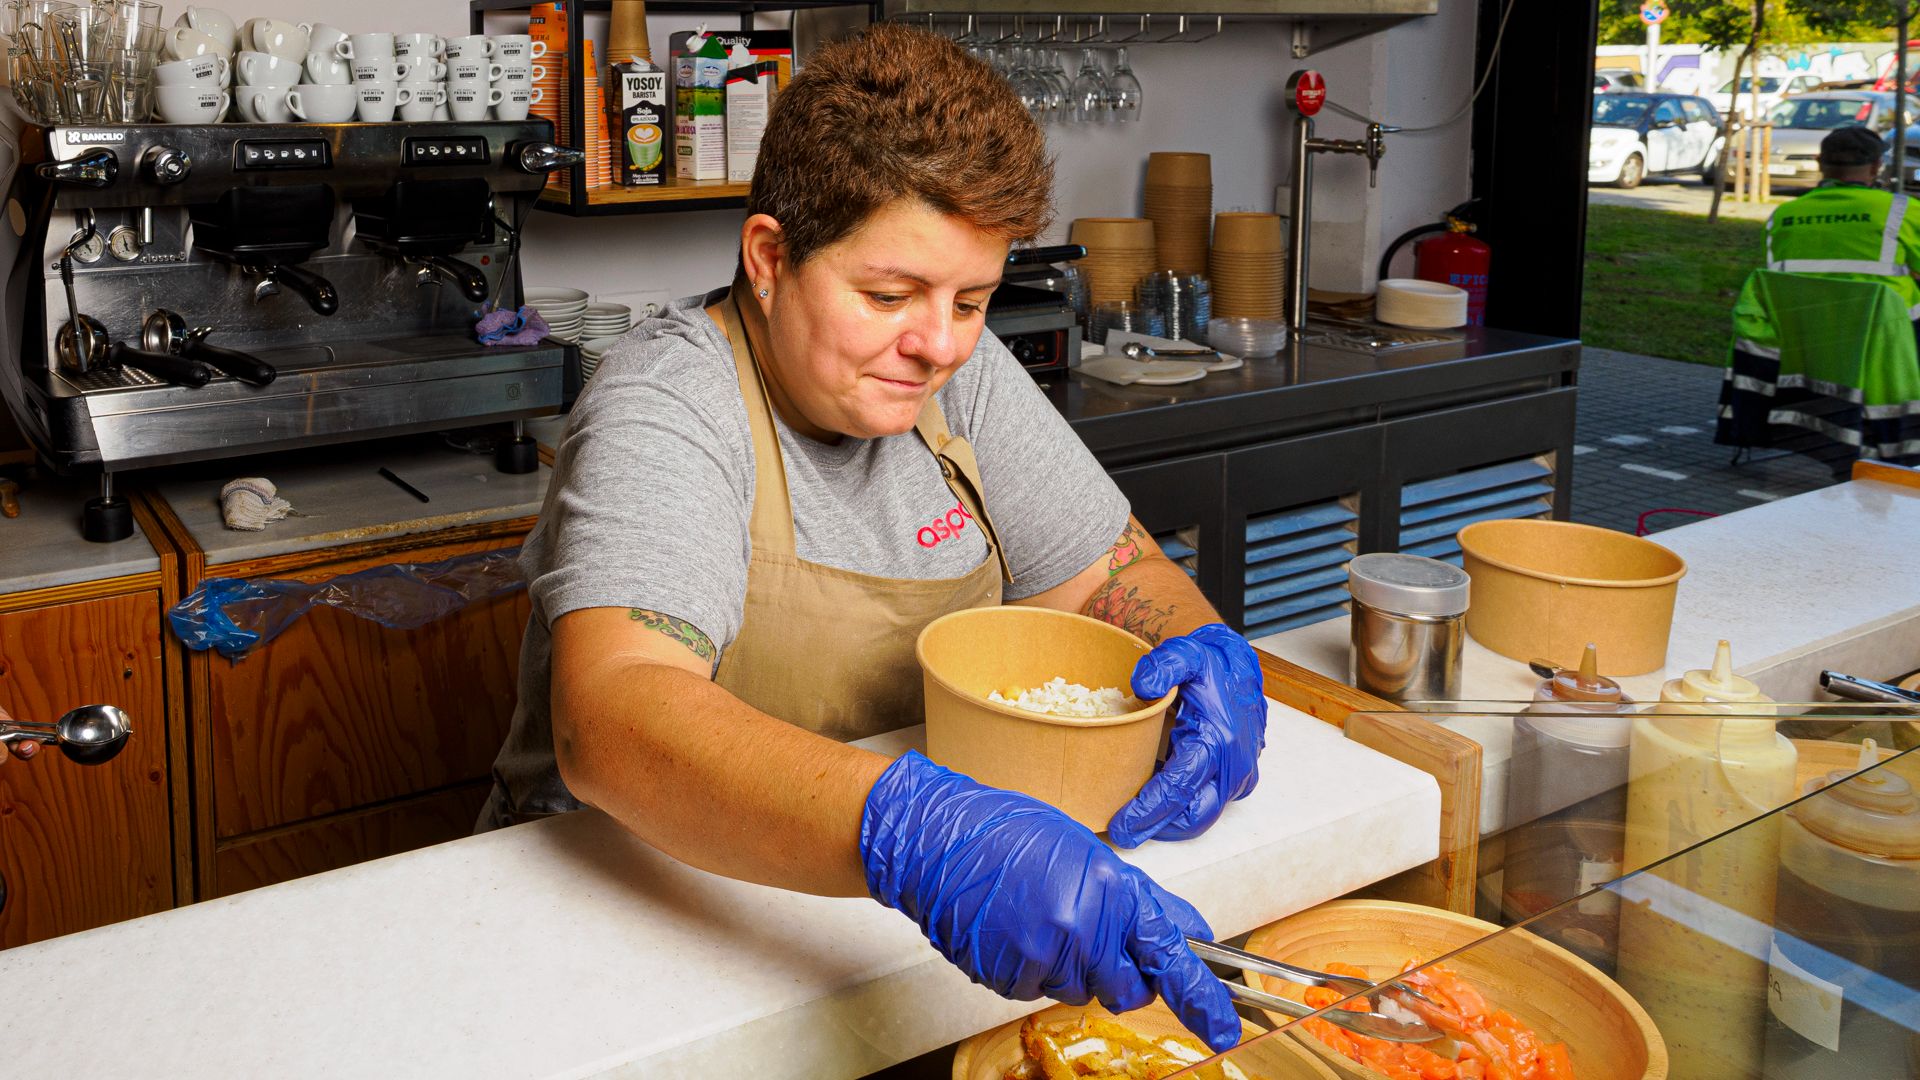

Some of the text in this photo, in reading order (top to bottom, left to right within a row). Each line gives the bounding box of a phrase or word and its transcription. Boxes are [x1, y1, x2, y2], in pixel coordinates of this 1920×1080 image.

[715, 36, 752, 47] Quality
[626, 77, 661, 90] YOSOY
[81, 133, 124, 141] RANCILIO
[1797, 213, 1871, 225] SETEMAR
